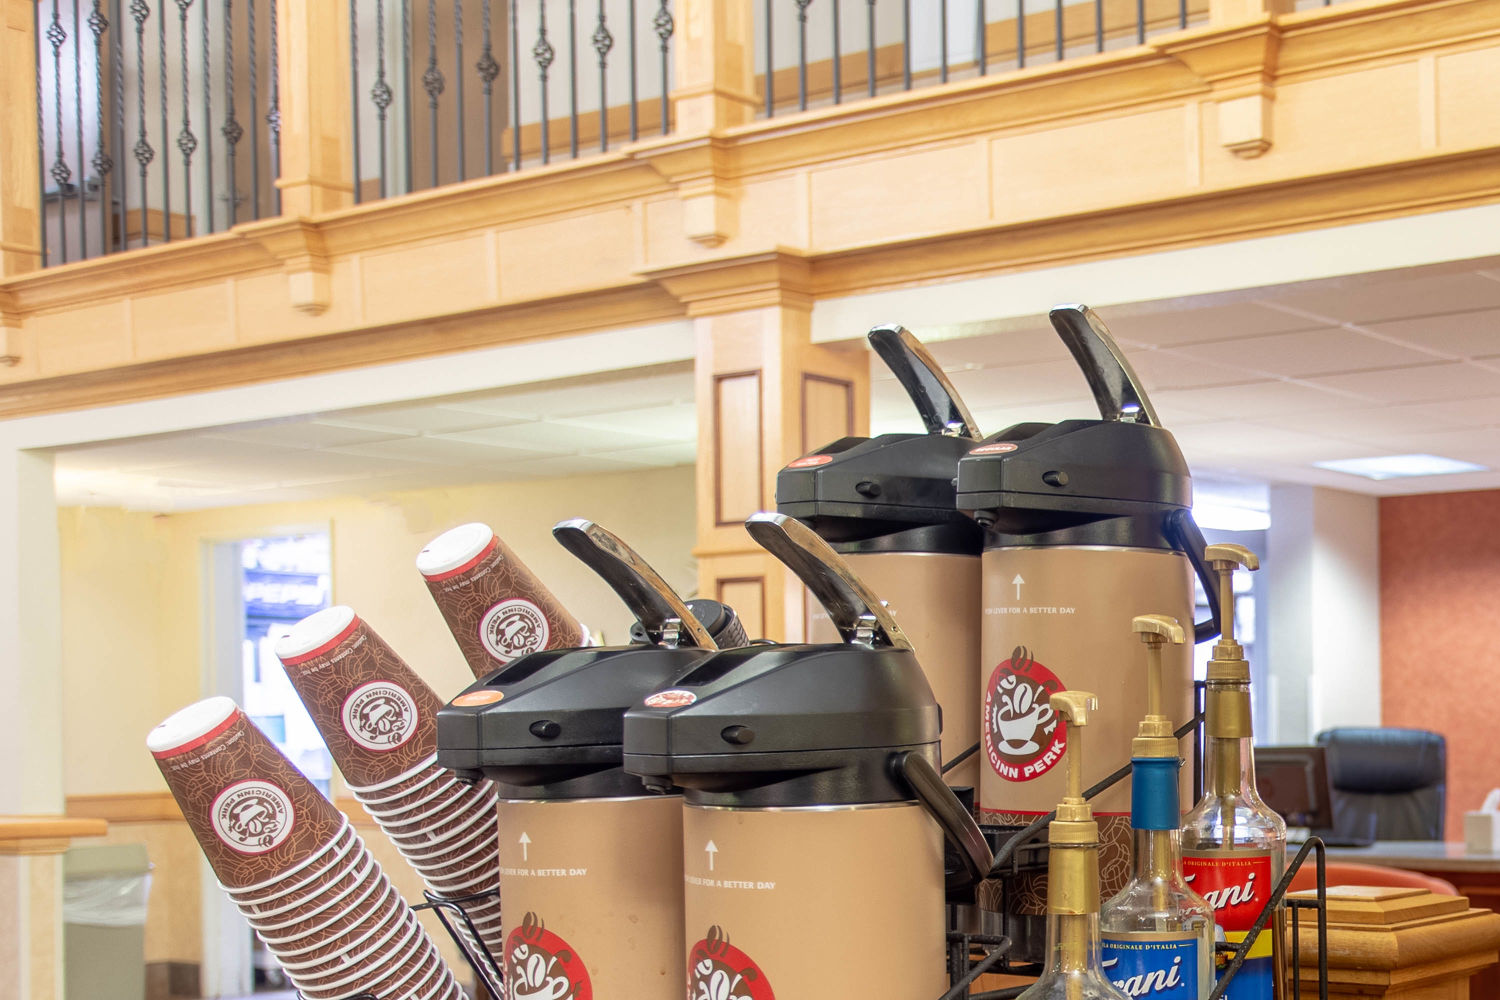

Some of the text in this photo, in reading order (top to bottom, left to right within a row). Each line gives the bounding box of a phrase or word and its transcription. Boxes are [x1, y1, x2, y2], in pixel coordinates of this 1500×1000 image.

[489, 607, 542, 635] AMERICINN PERK
[352, 690, 409, 721] AMERICINN PERK
[984, 691, 1066, 779] AMERICINN PERK
[199, 744, 227, 760] Contents
[220, 789, 284, 821] AMERICINN PERK
[537, 868, 567, 877] BETTER
[569, 868, 587, 876] DAY
[723, 880, 754, 889] BETTER
[757, 881, 776, 890] DAY
